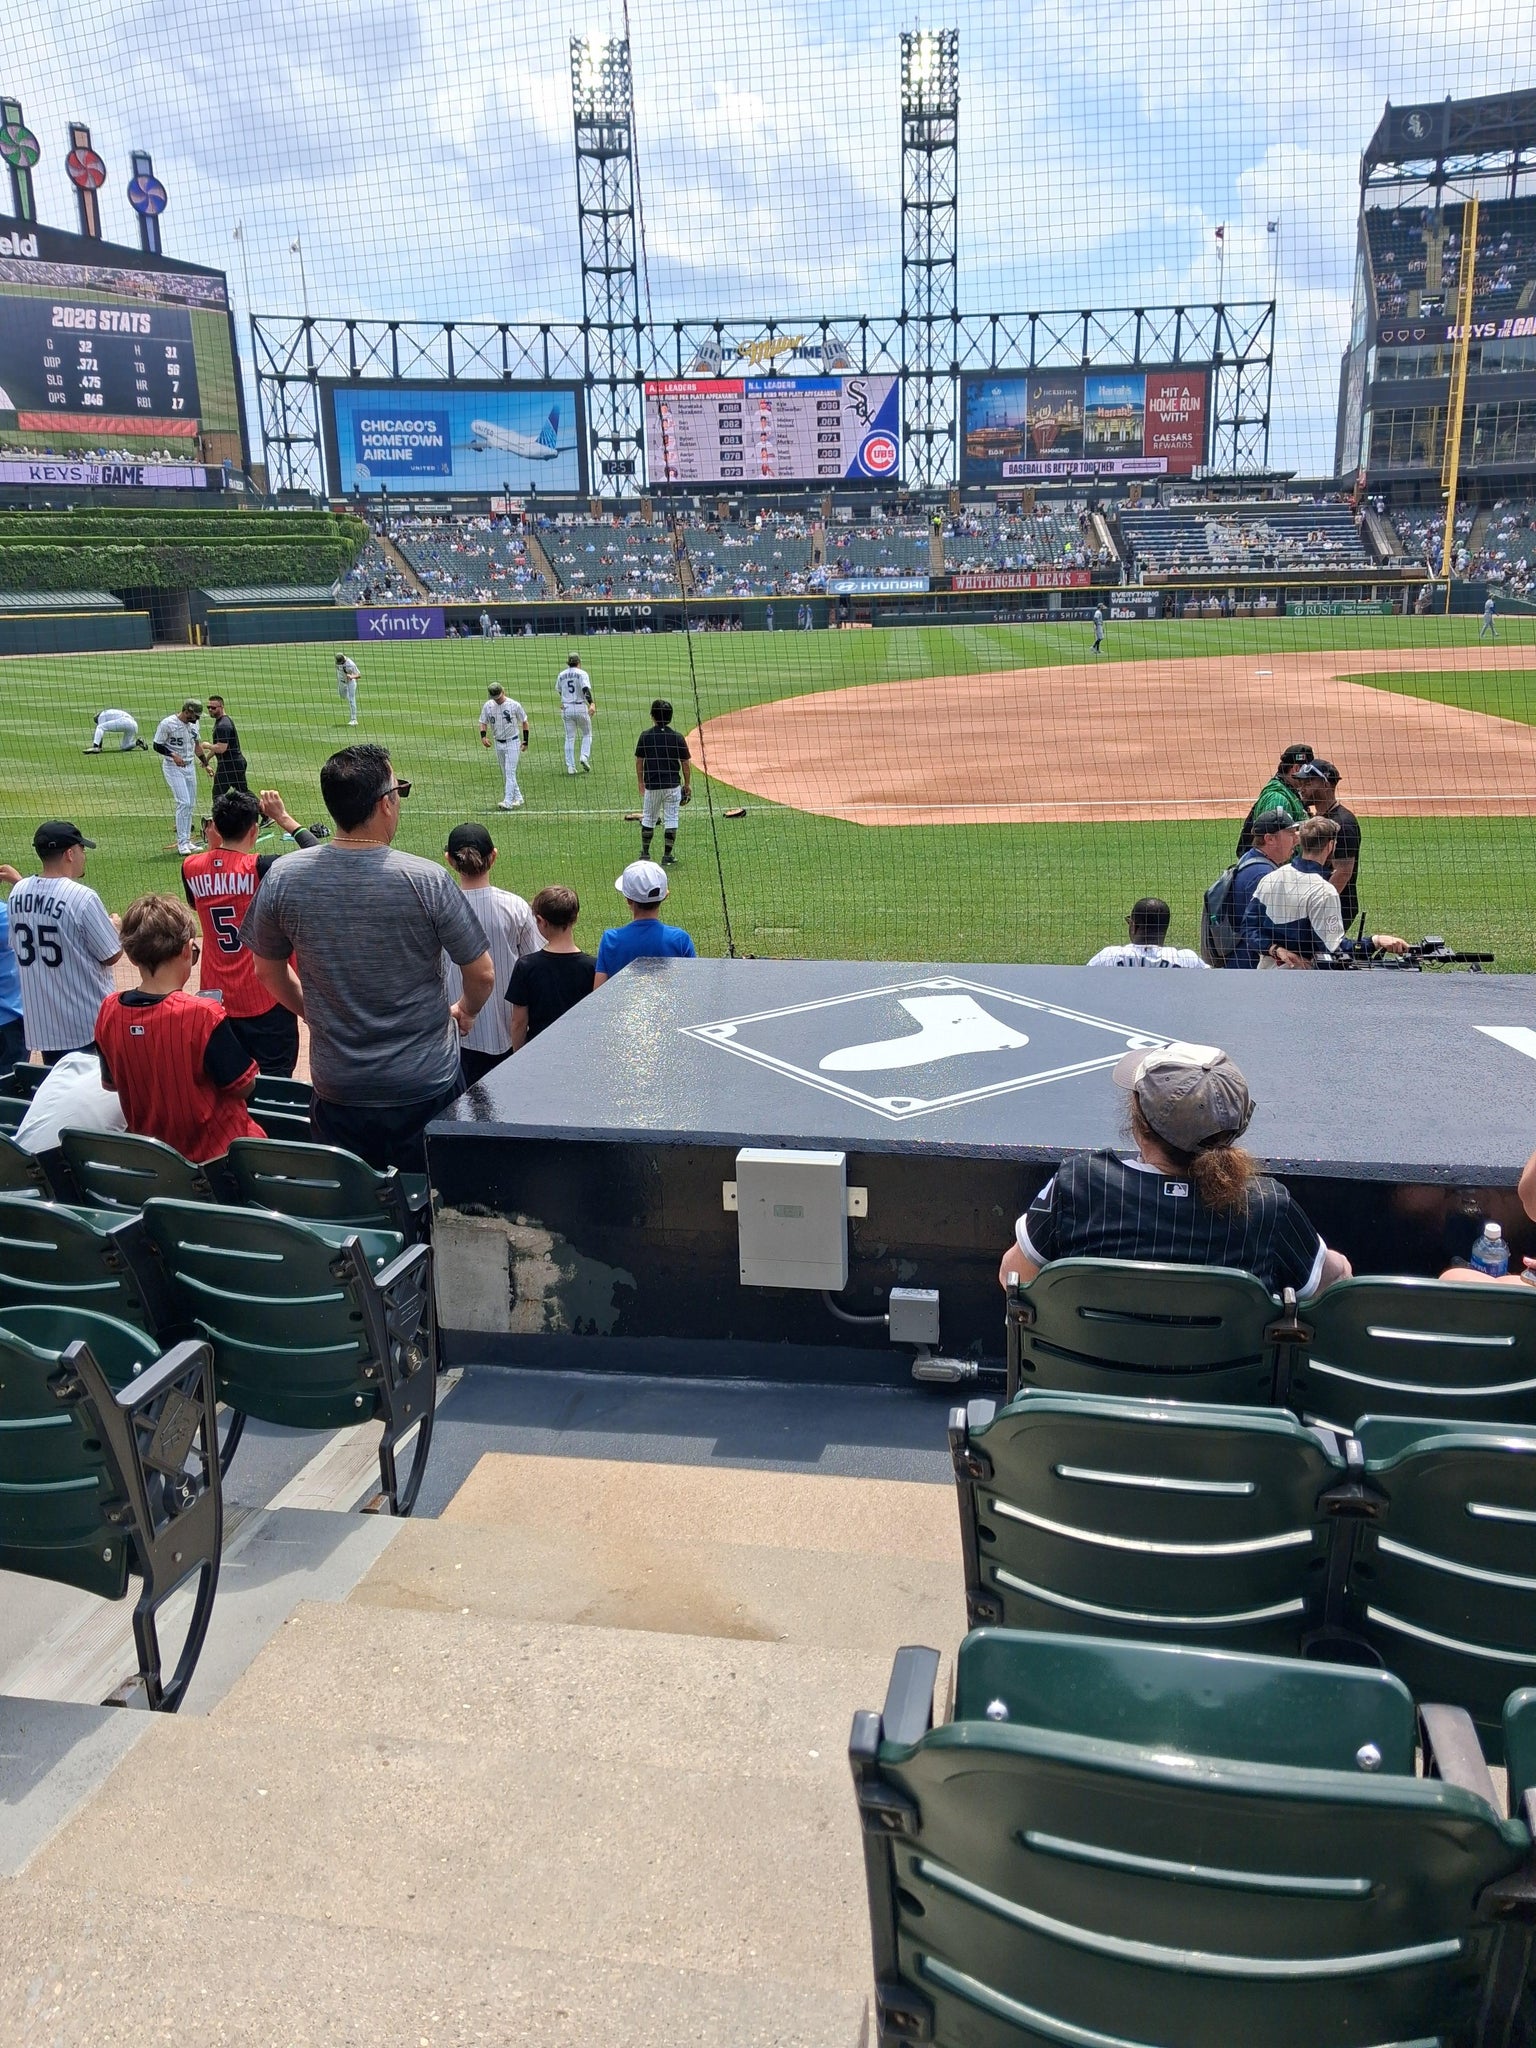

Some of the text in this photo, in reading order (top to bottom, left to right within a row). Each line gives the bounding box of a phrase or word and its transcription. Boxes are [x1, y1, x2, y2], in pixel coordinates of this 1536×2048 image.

[52, 306, 150, 334] 2026 STATS
[46, 339, 92, 353] G 32
[134, 345, 177, 358] H 31
[792, 346, 822, 359] TIME
[44, 356, 61, 368] OBP
[134, 362, 180, 376] TB 56
[46, 374, 101, 388] SLG .475
[136, 379, 179, 392] HR 7
[48, 392, 66, 403] OPS
[1161, 387, 1190, 397] HIT A
[172, 398, 184, 409] 17
[1150, 398, 1200, 412] HOME RUN
[1160, 412, 1189, 422] WITH
[360, 420, 437, 432] CHICAGO'S
[362, 435, 443, 446] HOMETOWN
[1153, 433, 1193, 442] CAESARS
[1153, 442, 1193, 450] REWARDS
[364, 449, 412, 460] AIRLINE
[1009, 464, 1044, 474] BASEBALL
[1045, 463, 1052, 474] IS
[1053, 462, 1078, 473] BETTER
[1080, 462, 1115, 472] TOGETHER
[30, 465, 144, 484] KEYS TO THE GAME
[861, 581, 923, 590] HYUNDAI
[956, 572, 1071, 589] WHITTINGHAM MEATS
[586, 606, 609, 616] THE
[1111, 608, 1136, 618] Rate
[1306, 605, 1337, 615] RUSH
[369, 613, 430, 636] xfinity
[567, 680, 575, 693] 5
[170, 737, 183, 746] 25
[187, 873, 254, 898] MURAKAMI
[10, 894, 66, 919] THOMAS
[210, 906, 242, 953] 5
[15, 923, 63, 967] 35
[182, 1487, 189, 1497] 6
